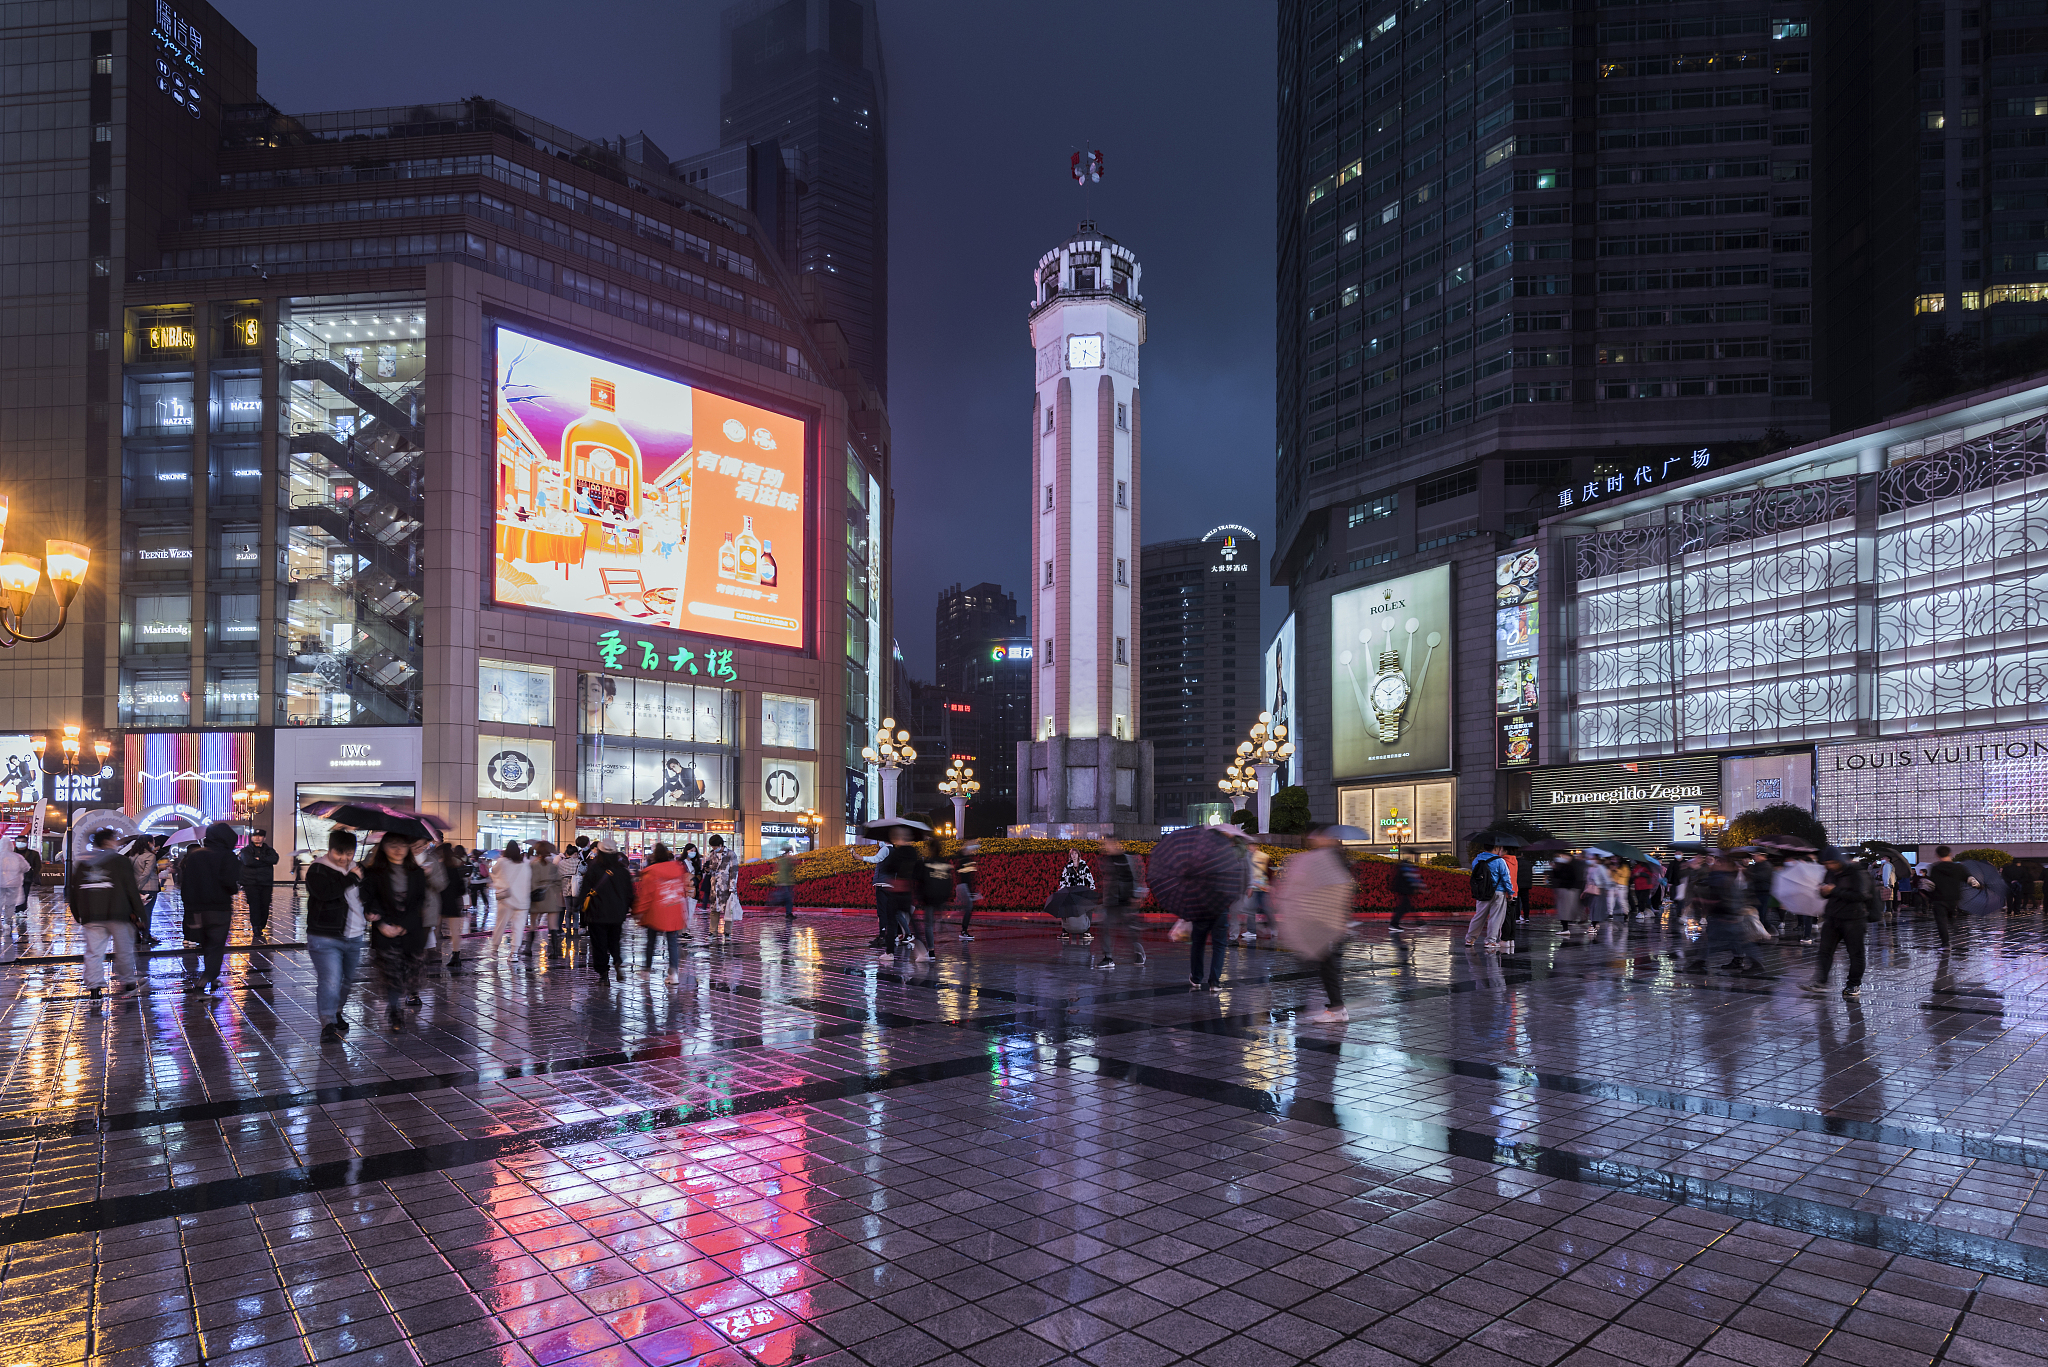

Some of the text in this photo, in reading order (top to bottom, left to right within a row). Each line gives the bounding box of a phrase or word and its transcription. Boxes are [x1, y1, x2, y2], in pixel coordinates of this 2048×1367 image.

[163, 418, 192, 426] HAZZYS
[696, 450, 785, 488] 有情有劲
[1557, 448, 1710, 509] 重庆时代广场
[735, 480, 799, 512] 有滋味
[139, 550, 169, 560] TEENIE
[1210, 564, 1248, 573] 大世界酒店
[1370, 599, 1406, 615] ROLEX
[597, 630, 738, 683] 重百大楼
[1008, 647, 1033, 659] 重庆
[147, 695, 179, 703] ERDOS
[340, 744, 371, 758] IWC
[1836, 740, 2048, 771] LOUIS VUITTON
[1550, 783, 1703, 805] Ermenegildo Zegna
[175, 804, 202, 820] CHINA
